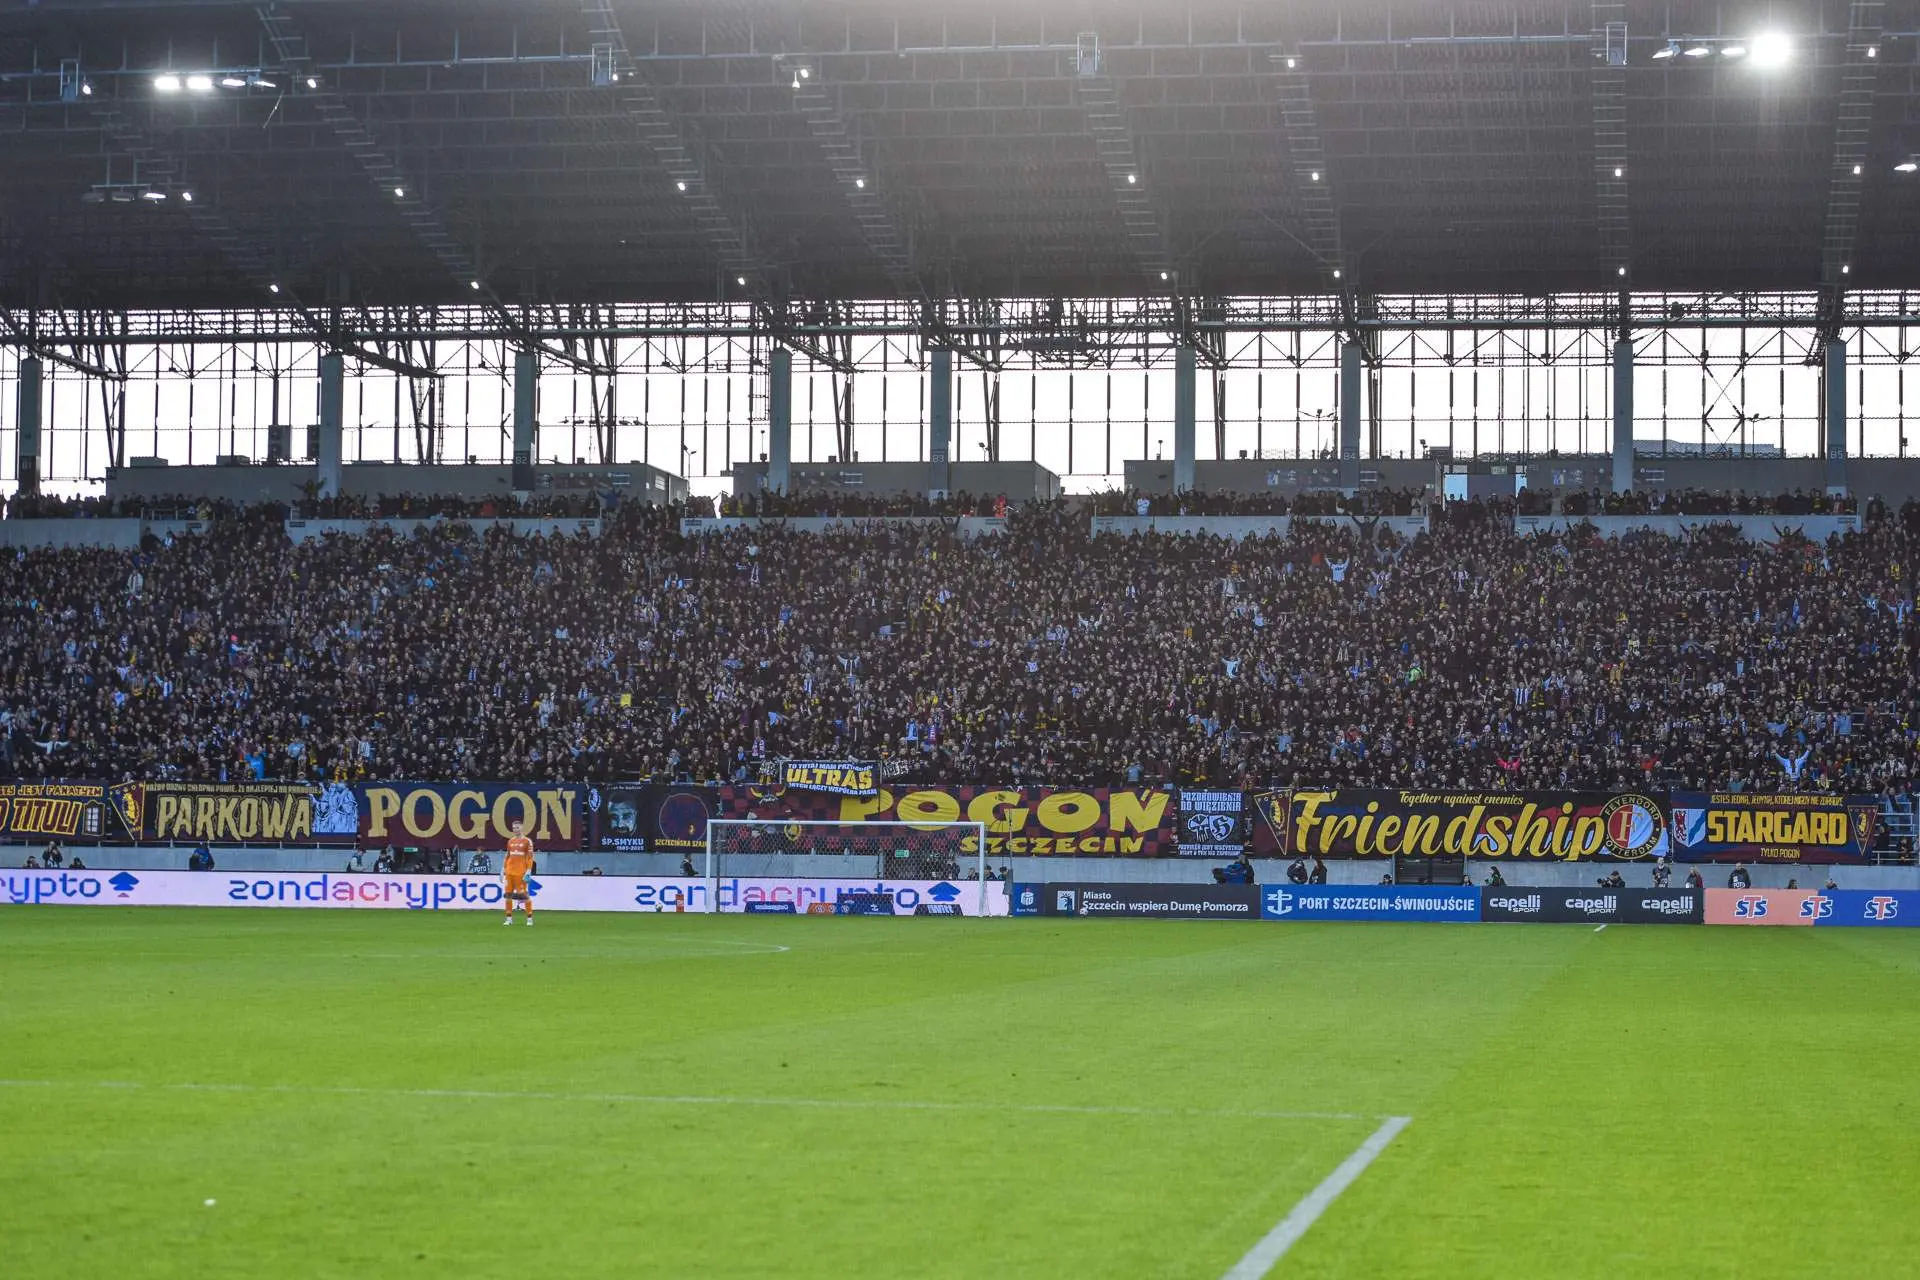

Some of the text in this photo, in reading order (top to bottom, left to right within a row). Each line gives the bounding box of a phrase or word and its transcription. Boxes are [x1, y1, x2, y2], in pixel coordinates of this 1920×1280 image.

[786, 768, 873, 790] ULTRAS
[18, 785, 43, 795] JEST
[46, 785, 103, 797] FANATYZM
[1181, 792, 1242, 801] POZDROWIENIA
[1400, 791, 1523, 807] Together against enemies
[11, 798, 82, 835] TITULI
[157, 794, 312, 841] PARKOWA
[365, 787, 577, 840] POGOŃ
[1181, 802, 1241, 813] DO WIĘZIENIA
[1605, 796, 1660, 820] FEYENOORD
[1293, 790, 1605, 861] Friendship
[1707, 810, 1847, 845] STARGARD
[959, 836, 1143, 853] SZCZECIN
[0, 873, 101, 904] ypto
[228, 874, 503, 910] zondacrypto
[1083, 891, 1111, 900] Miasto
[1082, 901, 1248, 913] Szczecin wspiera Dumę Pomorza
[1299, 895, 1475, 911] PORT SZCZECIN-ŚWINOUJŚCIE
[1489, 894, 1541, 911] capelli
[1565, 895, 1617, 912] capelli
[1641, 896, 1693, 912] capelli
[1735, 895, 1768, 918] STS
[1800, 895, 1833, 918] STS
[1864, 896, 1898, 919] STS
